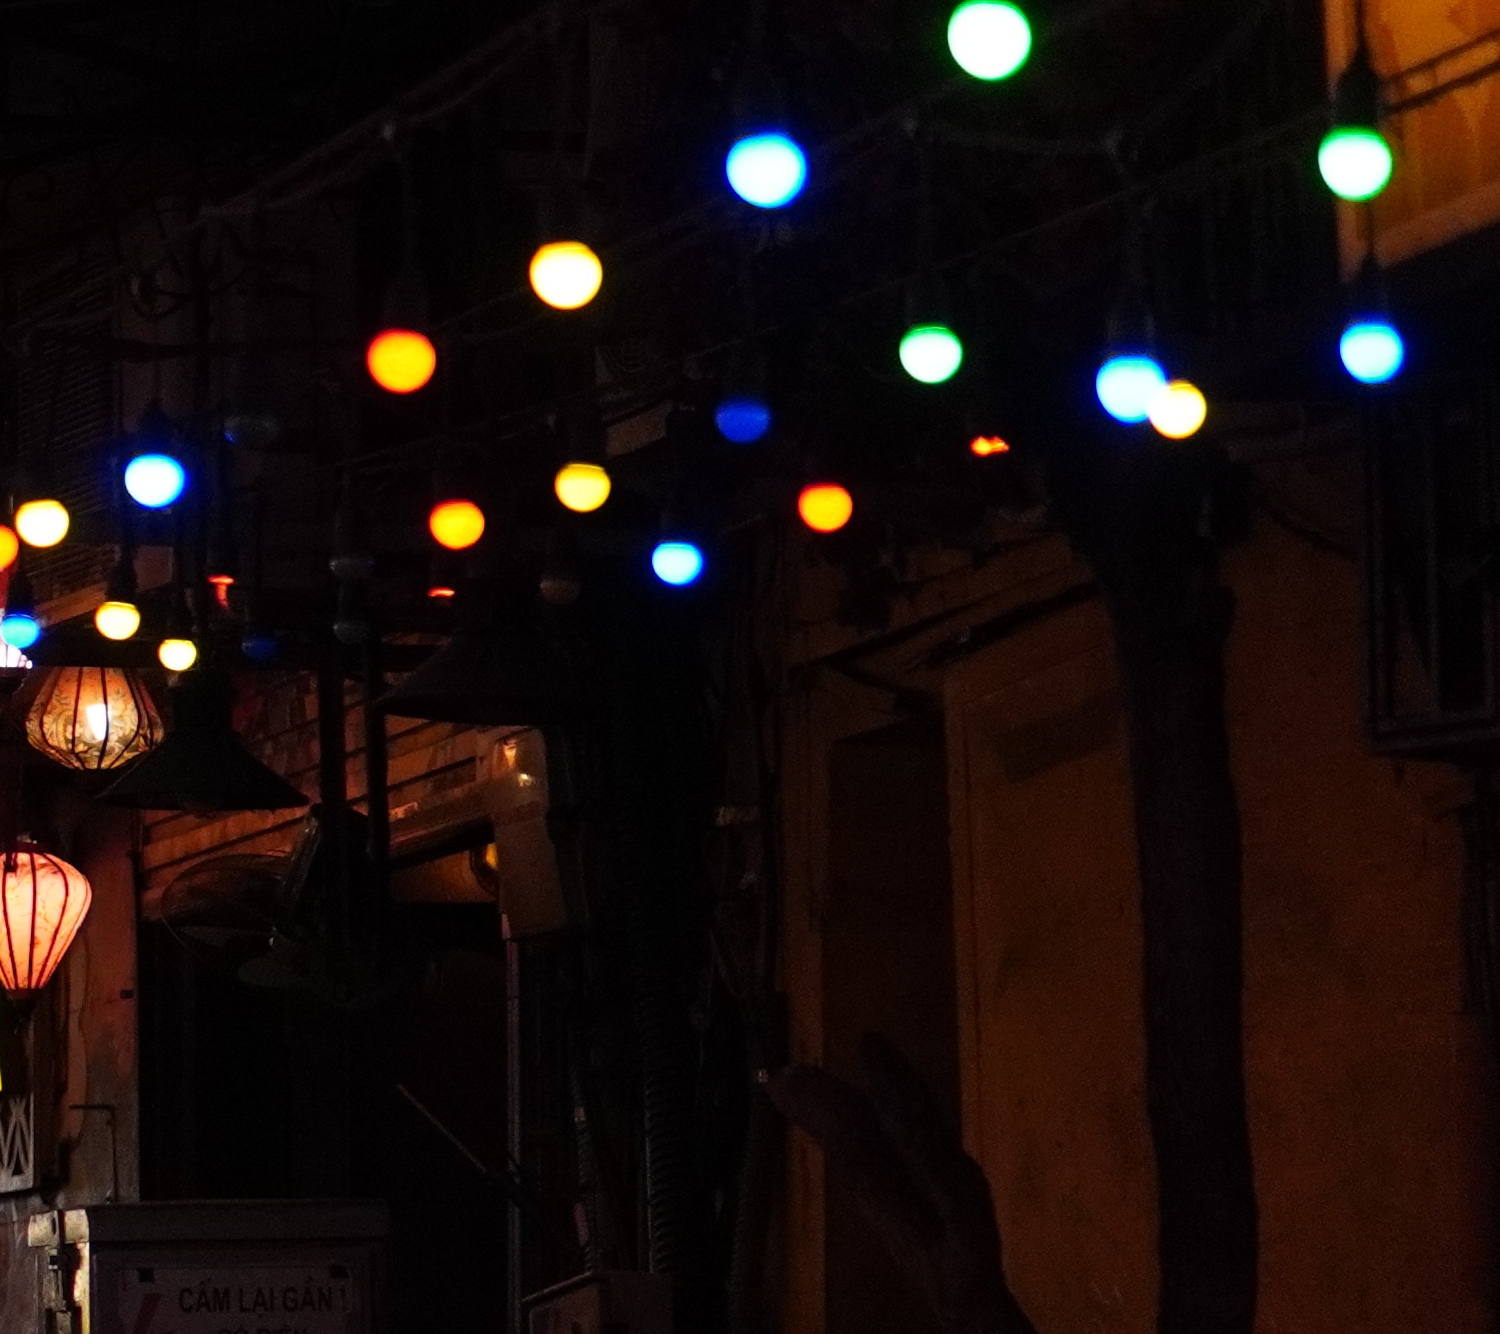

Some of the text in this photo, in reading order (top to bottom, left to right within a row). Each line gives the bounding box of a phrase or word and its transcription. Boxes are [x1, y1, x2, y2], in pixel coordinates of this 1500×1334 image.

[178, 1277, 231, 1314] CẤM
[238, 1286, 275, 1318] LẠI
[282, 1276, 333, 1313] GẦN
